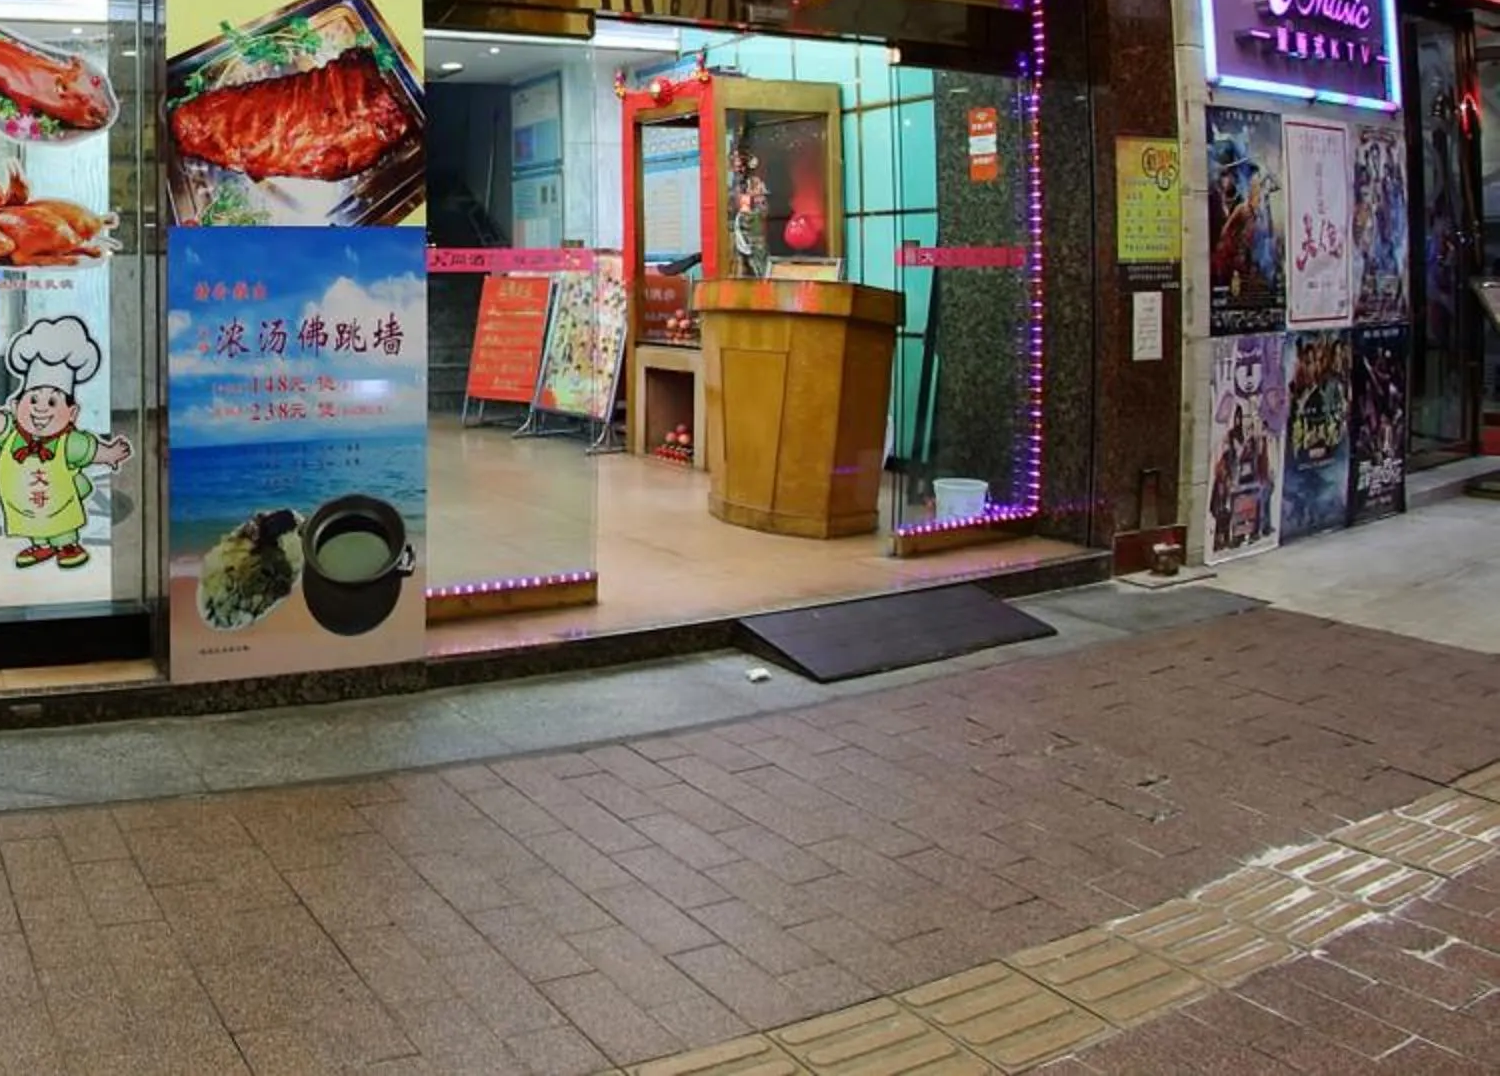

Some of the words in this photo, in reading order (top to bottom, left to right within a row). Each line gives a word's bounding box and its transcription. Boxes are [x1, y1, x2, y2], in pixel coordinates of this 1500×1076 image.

[216, 312, 405, 360] 浓汤佛跳墙
